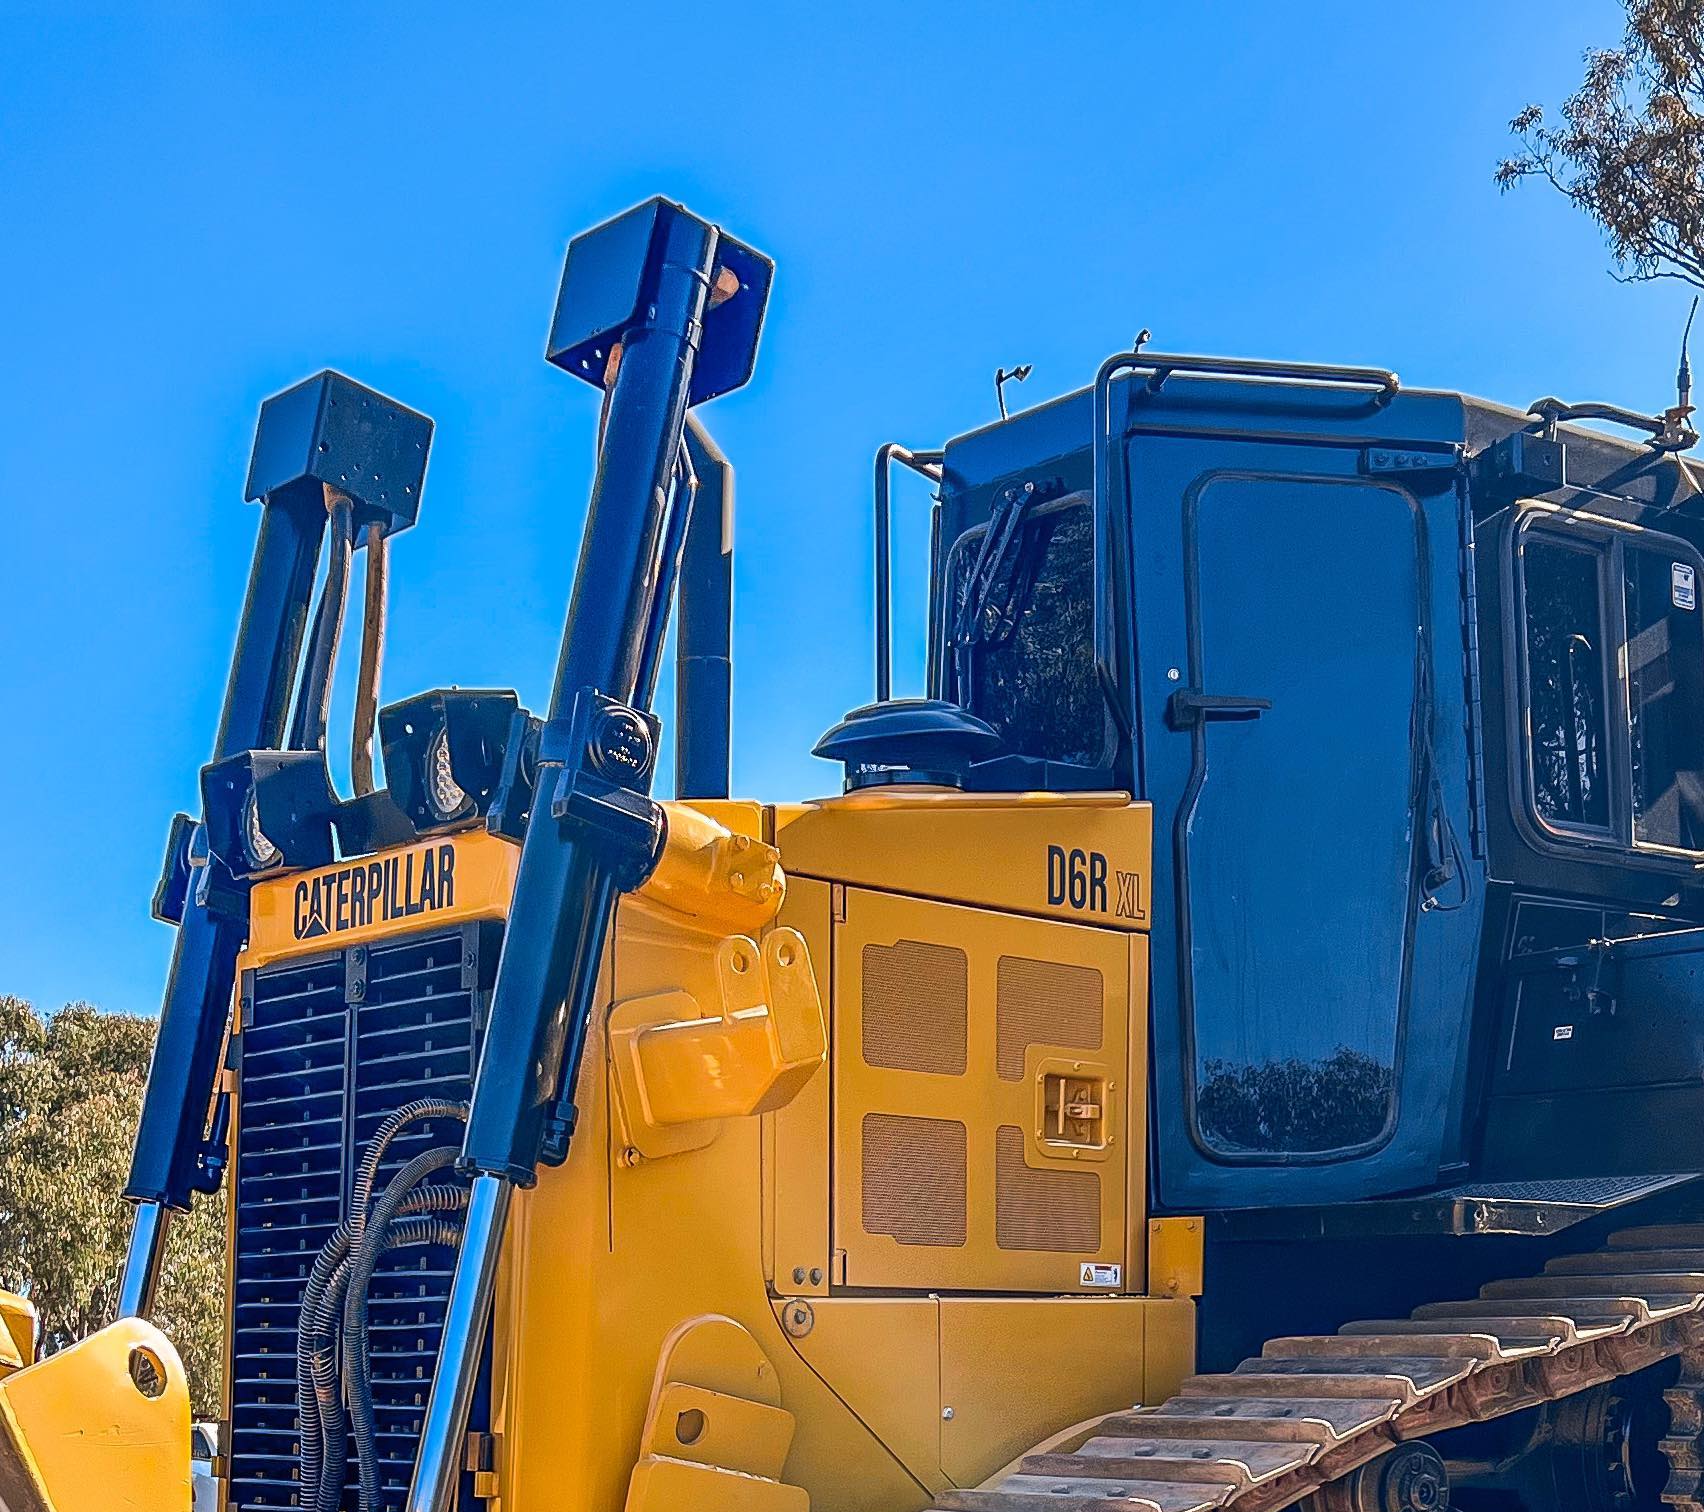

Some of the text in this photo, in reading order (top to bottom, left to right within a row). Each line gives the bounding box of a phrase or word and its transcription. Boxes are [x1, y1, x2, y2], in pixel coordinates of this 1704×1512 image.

[294, 844, 455, 940] CATERPILLAR
[1047, 844, 1146, 920] D6R XL
